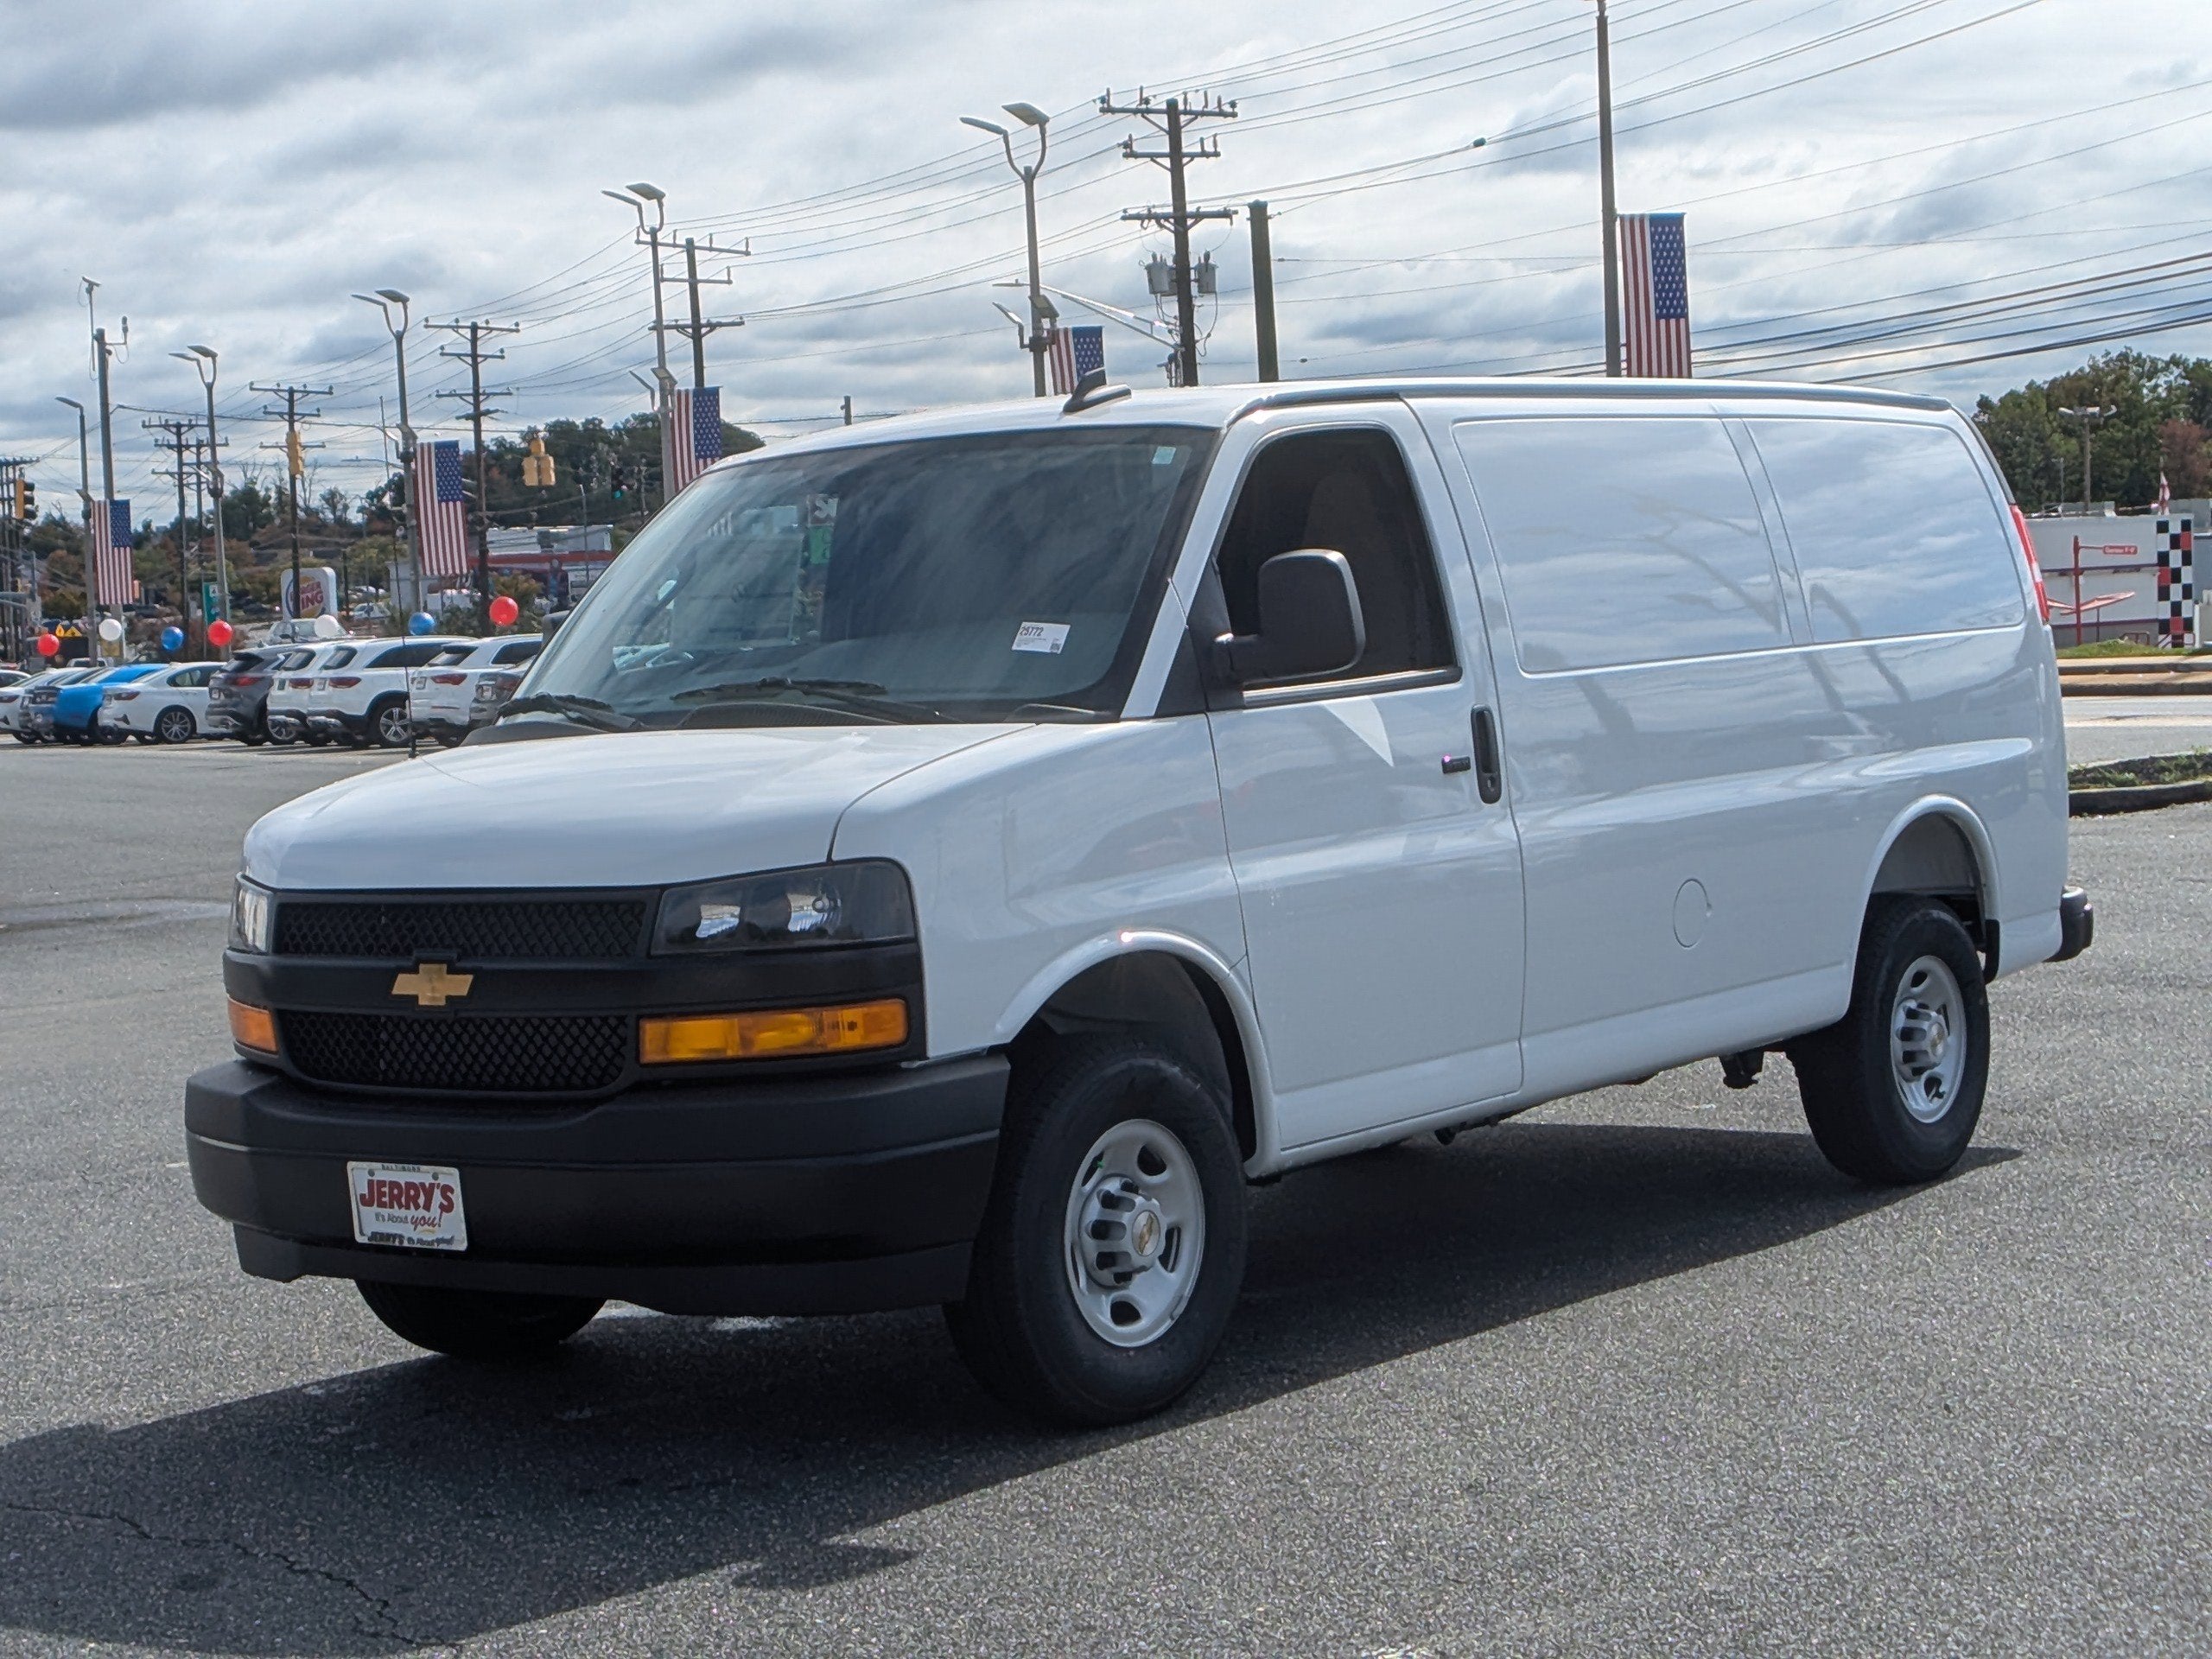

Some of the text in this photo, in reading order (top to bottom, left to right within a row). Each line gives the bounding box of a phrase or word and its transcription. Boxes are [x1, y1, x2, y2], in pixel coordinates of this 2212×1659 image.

[290, 581, 321, 602] RGER
[298, 590, 323, 610] ING
[359, 1179, 454, 1213] JERRY'S
[410, 1210, 442, 1231] you!
